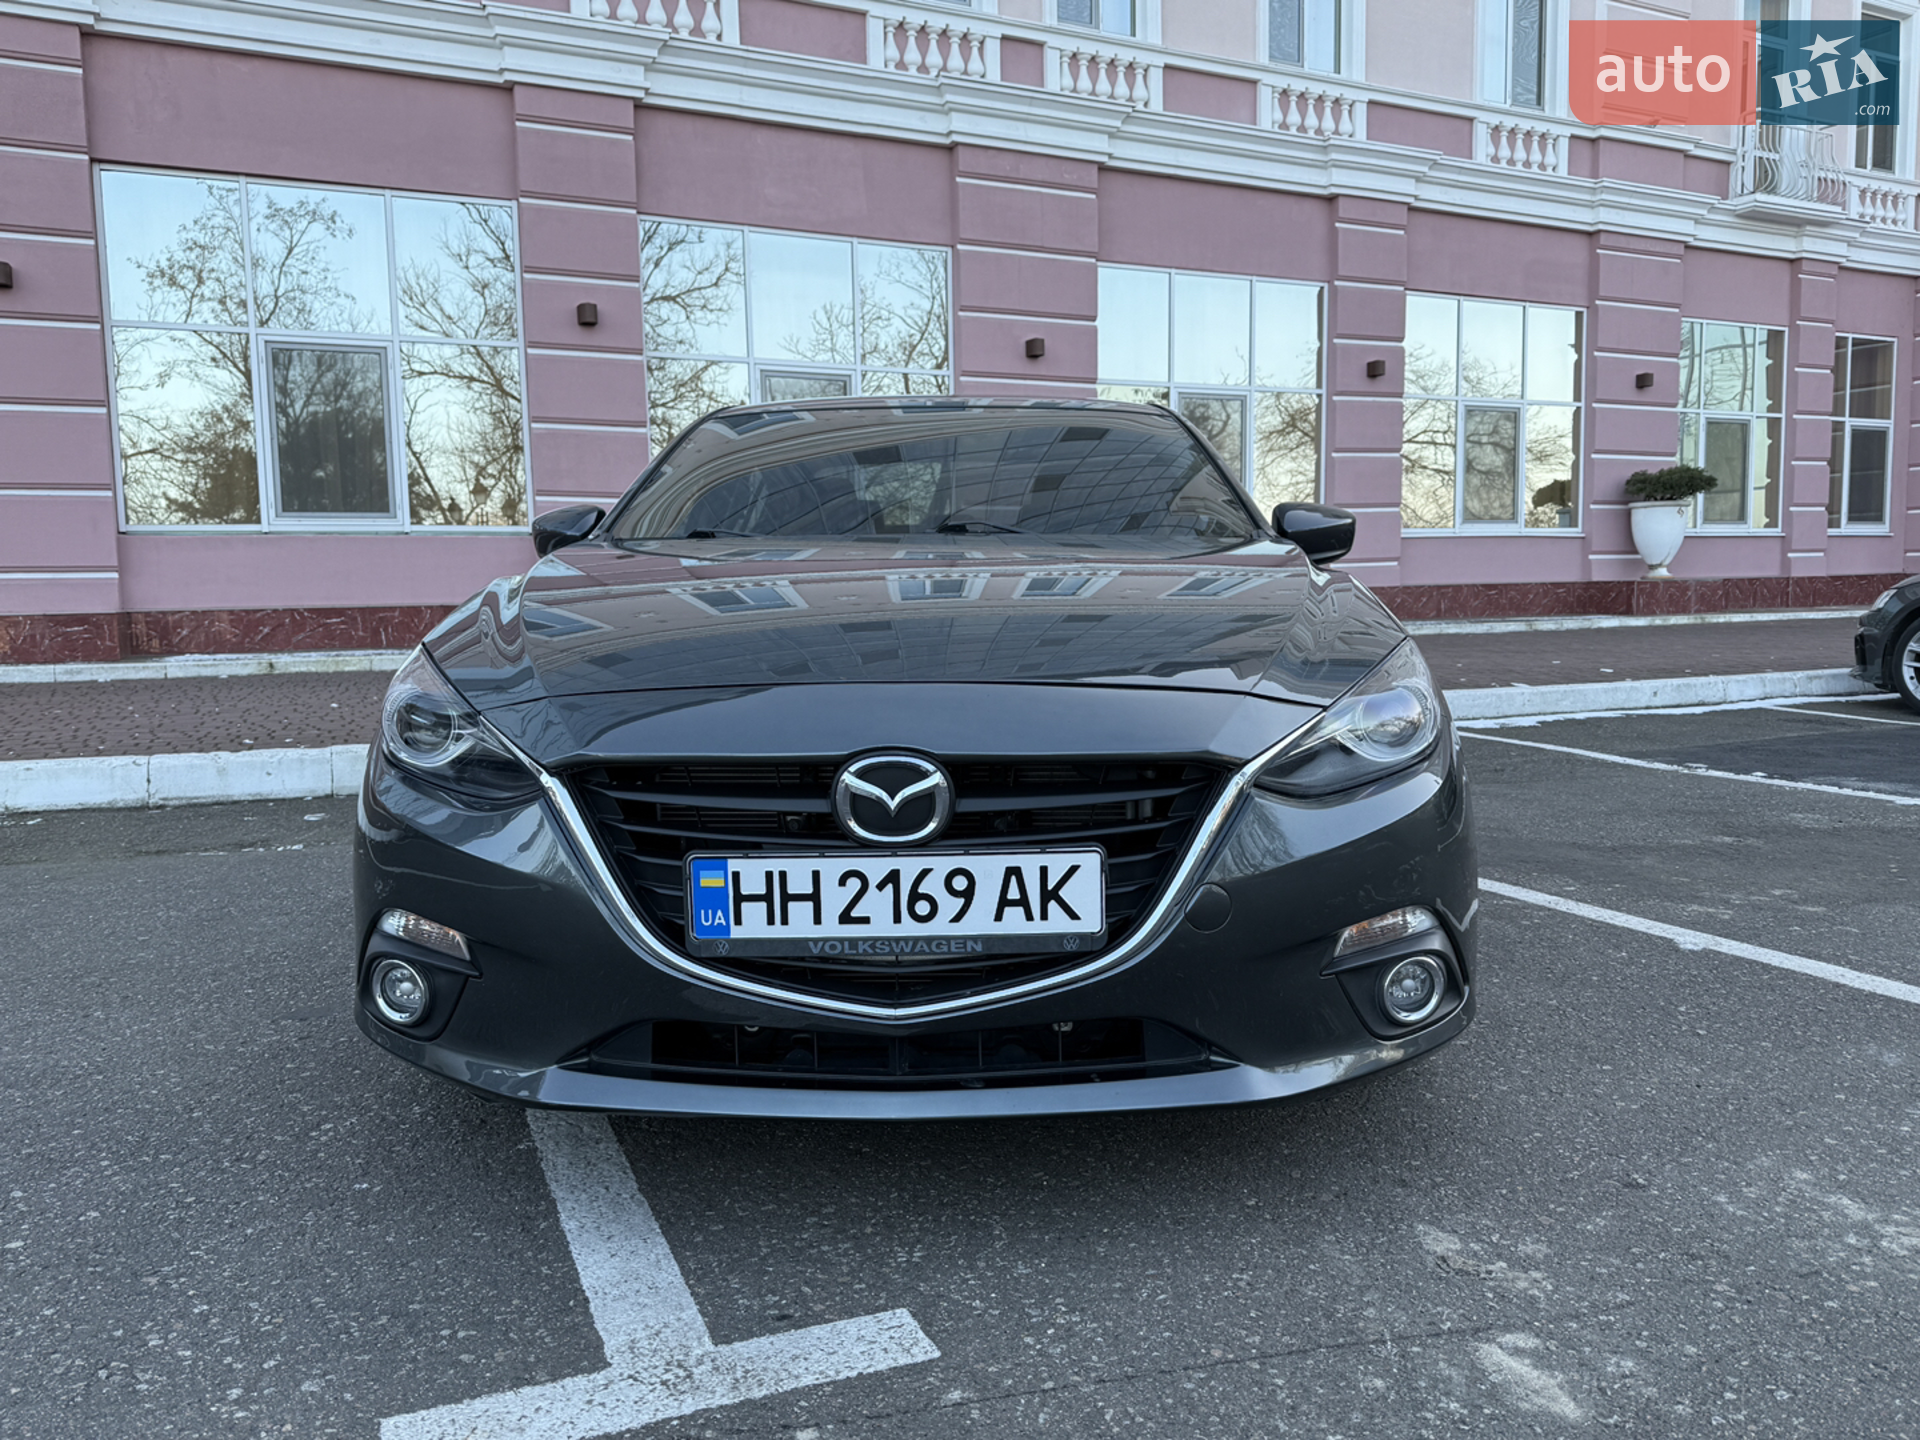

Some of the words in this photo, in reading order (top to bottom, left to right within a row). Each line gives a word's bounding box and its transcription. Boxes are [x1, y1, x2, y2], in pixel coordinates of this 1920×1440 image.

[731, 869, 822, 926] HH
[837, 867, 976, 925] 2169
[993, 864, 1082, 922] AK
[701, 909, 726, 926] UA
[808, 939, 983, 955] VOLKSWAGEN
